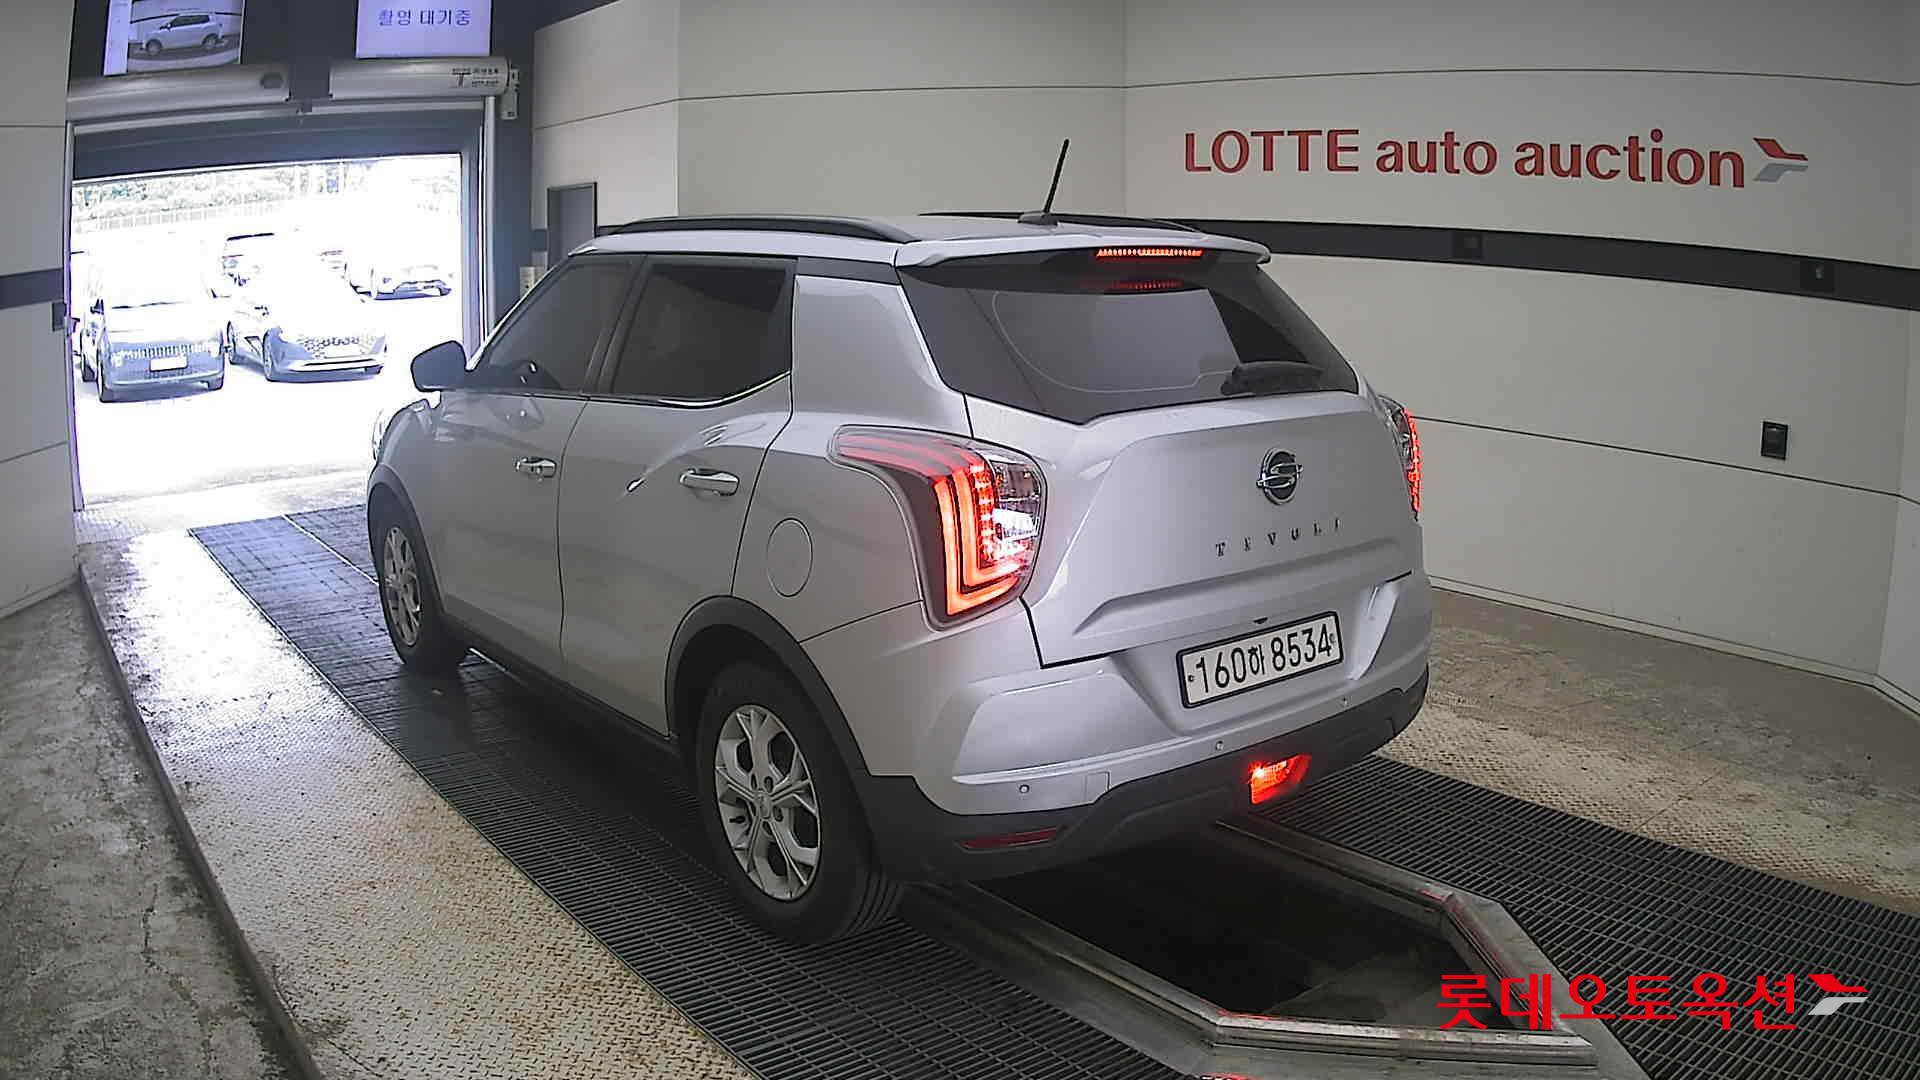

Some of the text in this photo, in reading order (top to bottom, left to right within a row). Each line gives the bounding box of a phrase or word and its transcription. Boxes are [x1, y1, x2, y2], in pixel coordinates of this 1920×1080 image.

[420, 8, 471, 26] 대기중
[1184, 128, 1745, 188] LOTTE auto auction
[1195, 623, 1332, 693] 160하 8534
